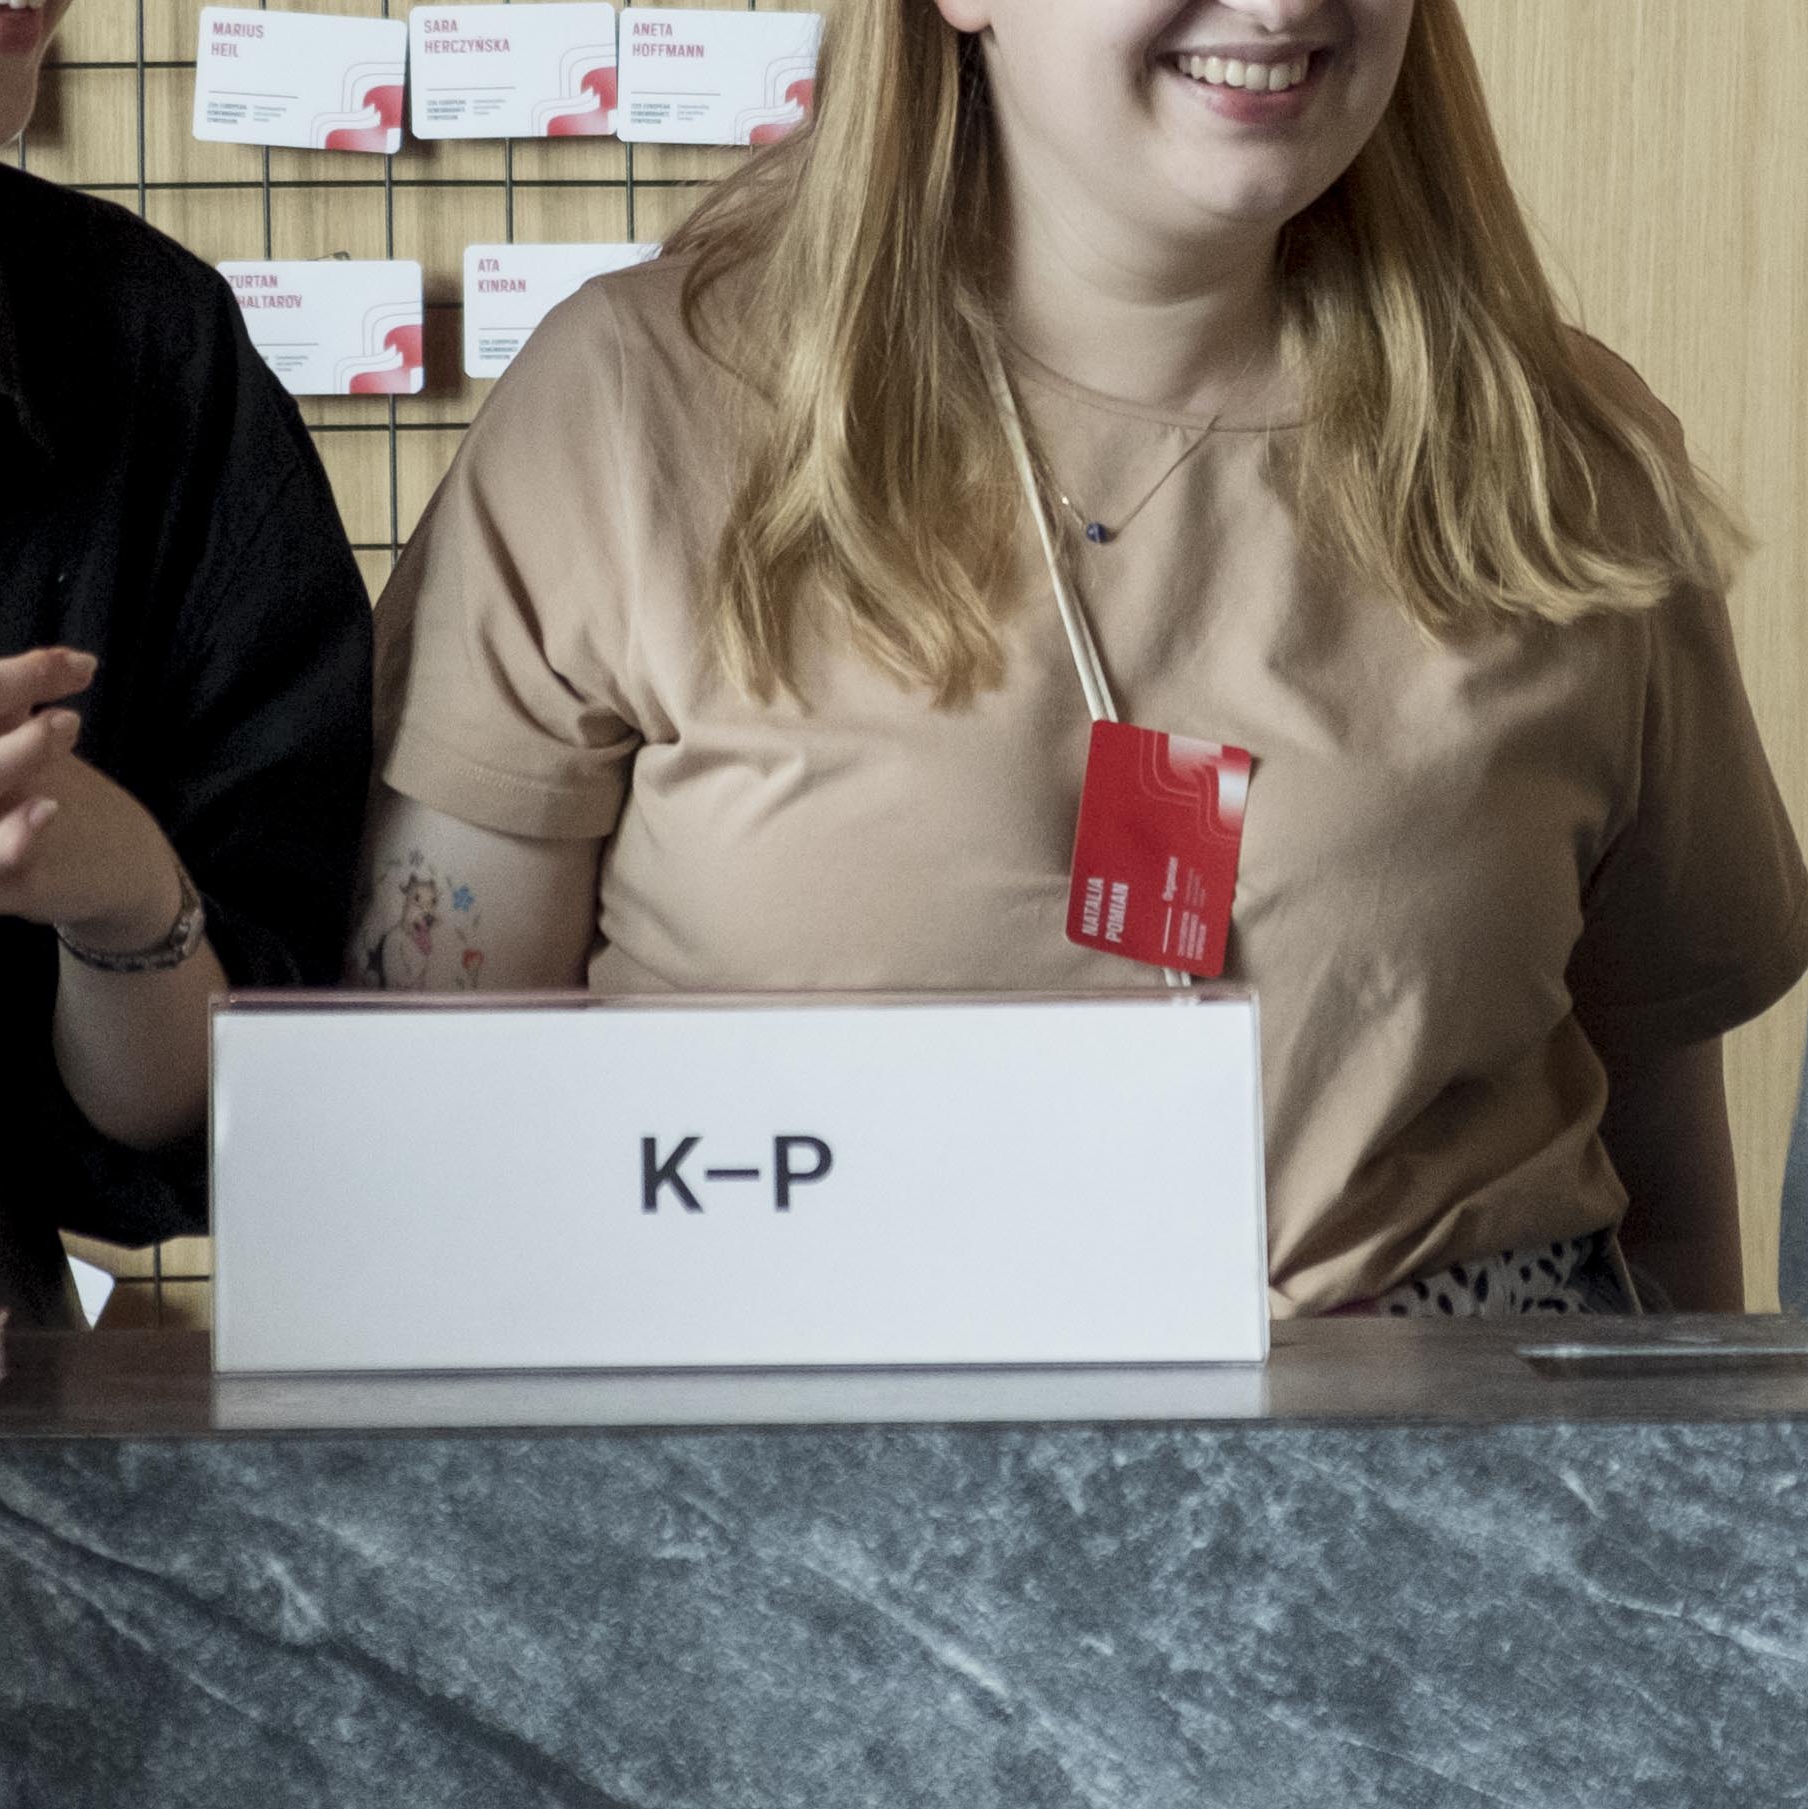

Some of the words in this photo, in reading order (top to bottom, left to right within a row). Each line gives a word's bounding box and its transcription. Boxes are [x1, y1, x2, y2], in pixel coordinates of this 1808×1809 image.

[212, 21, 264, 39] MARIUS
[423, 19, 458, 34] SARA
[632, 22, 673, 37] ANETA
[211, 42, 239, 58] HEIL
[424, 38, 511, 54] HERCZYŃSKA
[632, 42, 705, 59] HOFFMANN
[477, 258, 500, 273] ATA
[477, 279, 527, 293] KINRAN
[235, 294, 303, 309] HALTAROV
[1081, 877, 1105, 937] NATALIA
[1105, 881, 1129, 943] POMIAN
